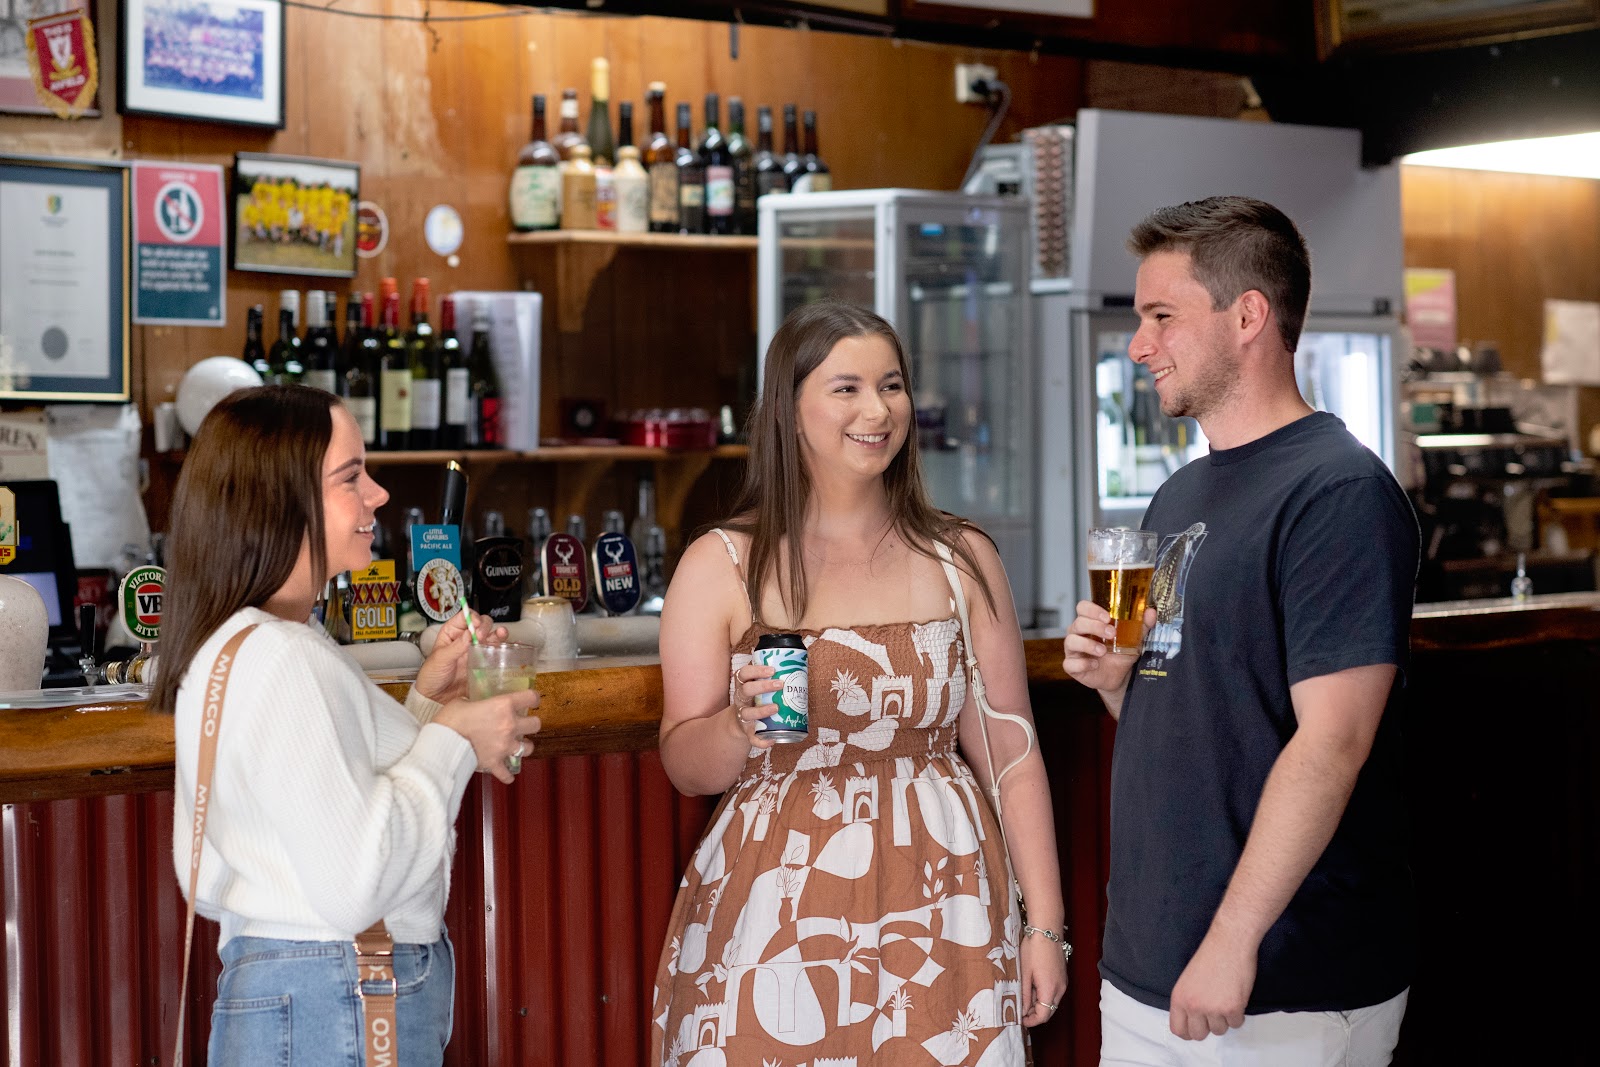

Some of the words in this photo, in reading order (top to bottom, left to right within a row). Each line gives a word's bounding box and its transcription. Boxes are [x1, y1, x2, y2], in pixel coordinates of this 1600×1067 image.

[485, 565, 520, 577] GUINNESS
[351, 580, 401, 606] XXXX
[553, 578, 581, 592] OLD
[606, 576, 633, 592] NEW
[137, 595, 163, 614] VB
[356, 606, 395, 628] GOLD
[204, 653, 231, 737] MIMCO
[191, 783, 208, 870] MIMCO
